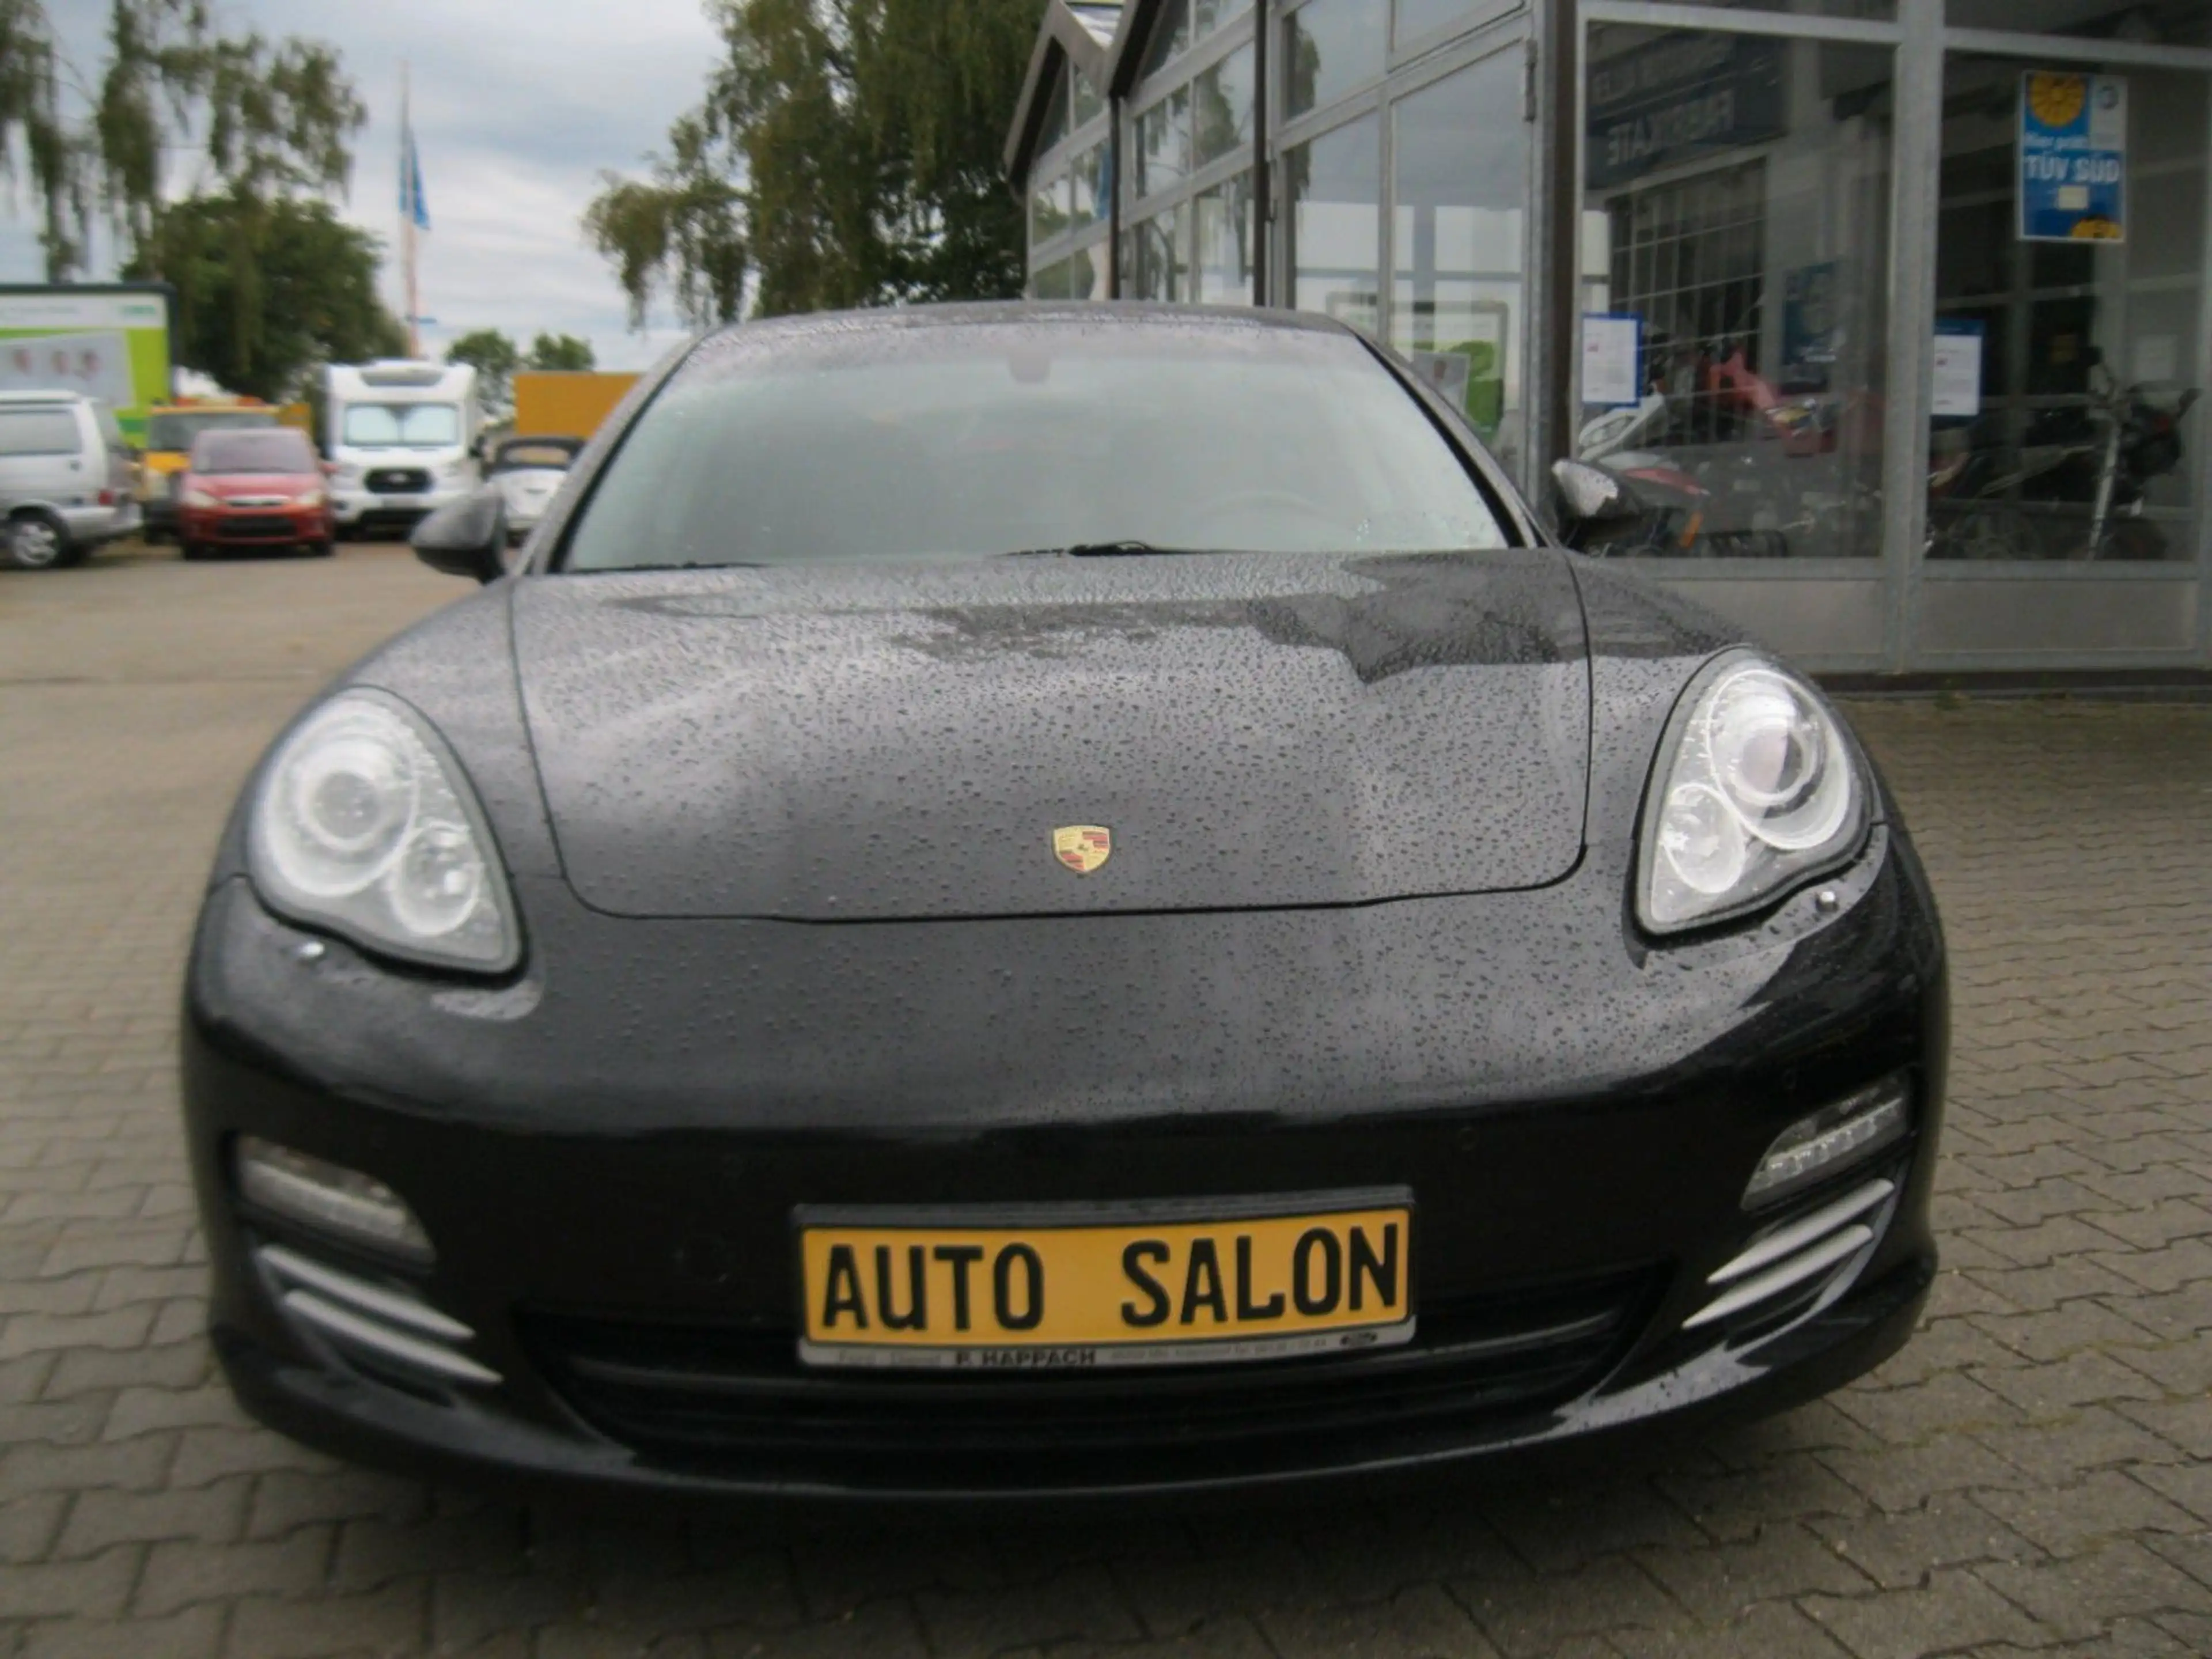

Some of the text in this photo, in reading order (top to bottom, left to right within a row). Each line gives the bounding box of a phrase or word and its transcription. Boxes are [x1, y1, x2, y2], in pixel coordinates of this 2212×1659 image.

[2024, 151, 2120, 183] TÜV SÜD
[820, 1223, 1399, 1331] AUTO SALON
[981, 1349, 1096, 1368] HAPPACH
